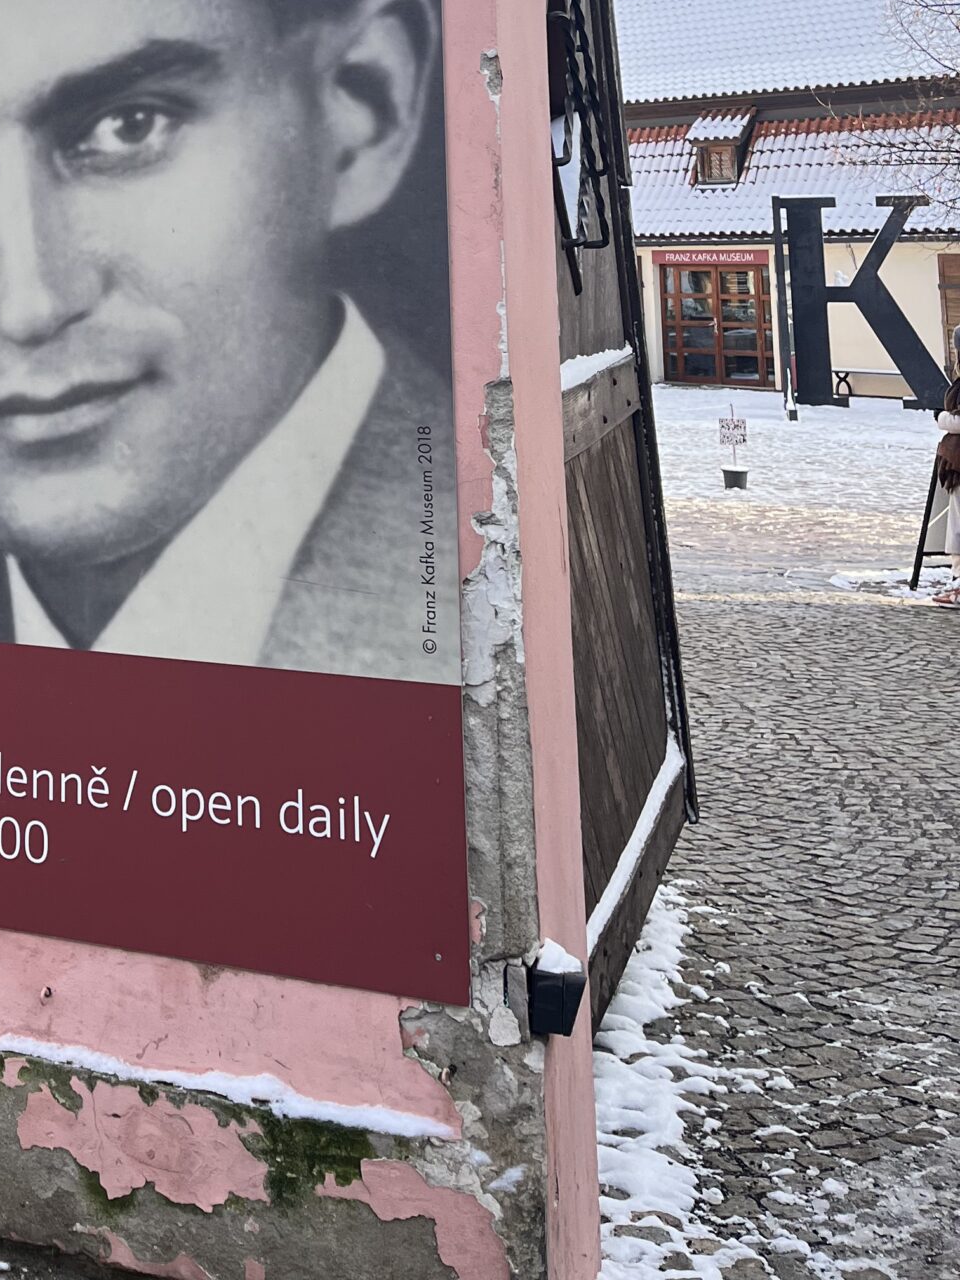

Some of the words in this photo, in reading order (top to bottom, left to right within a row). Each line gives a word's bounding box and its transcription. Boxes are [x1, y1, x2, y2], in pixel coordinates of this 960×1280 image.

[665, 252, 691, 262] FRANZ
[691, 252, 718, 262] KAFKA
[719, 252, 754, 262] MUSEUM
[416, 425, 433, 465] 2018
[419, 470, 435, 536] Museum
[419, 540, 435, 585] Kafka
[422, 590, 437, 634] Franz
[123, 770, 138, 811] /
[151, 784, 261, 833] open
[279, 788, 390, 858] daily
